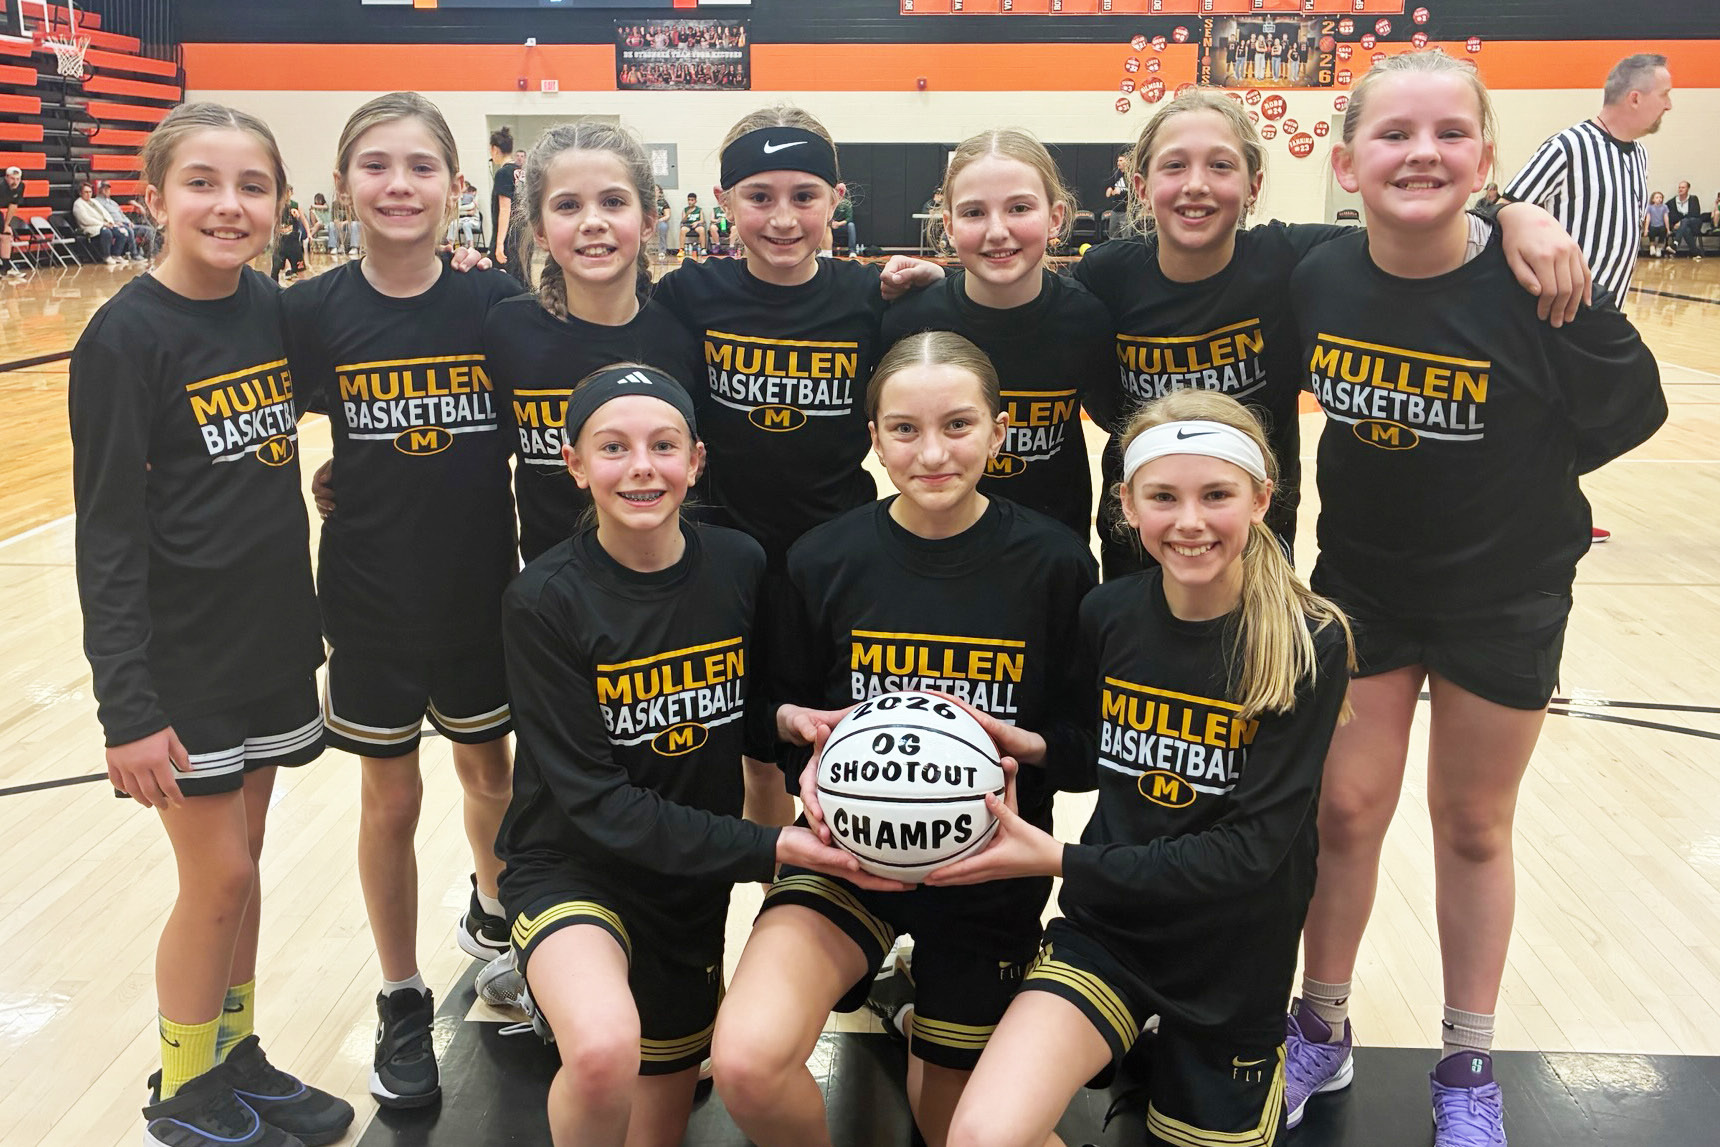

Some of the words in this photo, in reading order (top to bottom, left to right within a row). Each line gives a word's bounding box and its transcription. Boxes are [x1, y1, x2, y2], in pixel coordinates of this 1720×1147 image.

[544, 81, 556, 91] EXIT
[1264, 99, 1283, 110] ROBB
[1267, 107, 1283, 115] #24
[704, 340, 858, 379] MULLEN
[1116, 328, 1265, 374] MULLEN
[339, 366, 495, 400] MULLEN
[707, 366, 853, 406] BASKETBALL
[1120, 356, 1266, 399] BASKETBALL
[1311, 345, 1488, 404] MULLEN
[190, 369, 293, 425] MULLE
[344, 393, 497, 430] BASKETBALL
[1312, 372, 1485, 431] BASKETBALL
[764, 409, 790, 427] M
[1008, 399, 1075, 427] LEN
[270, 439, 287, 461] M
[411, 431, 438, 450] M
[1006, 422, 1065, 452] TBALL
[1372, 424, 1400, 446] M
[987, 457, 1012, 473] M
[597, 648, 745, 704] MULLEN
[851, 642, 1025, 683] MULLEN
[603, 678, 744, 736] BASKETBALL
[852, 696, 957, 721] 2026
[1102, 689, 1260, 749] MULLEN
[668, 728, 694, 751] M
[872, 732, 922, 756] OG
[829, 760, 978, 788] SHOOTOUT
[1152, 775, 1179, 803] M
[833, 807, 974, 851] CHAMPS
